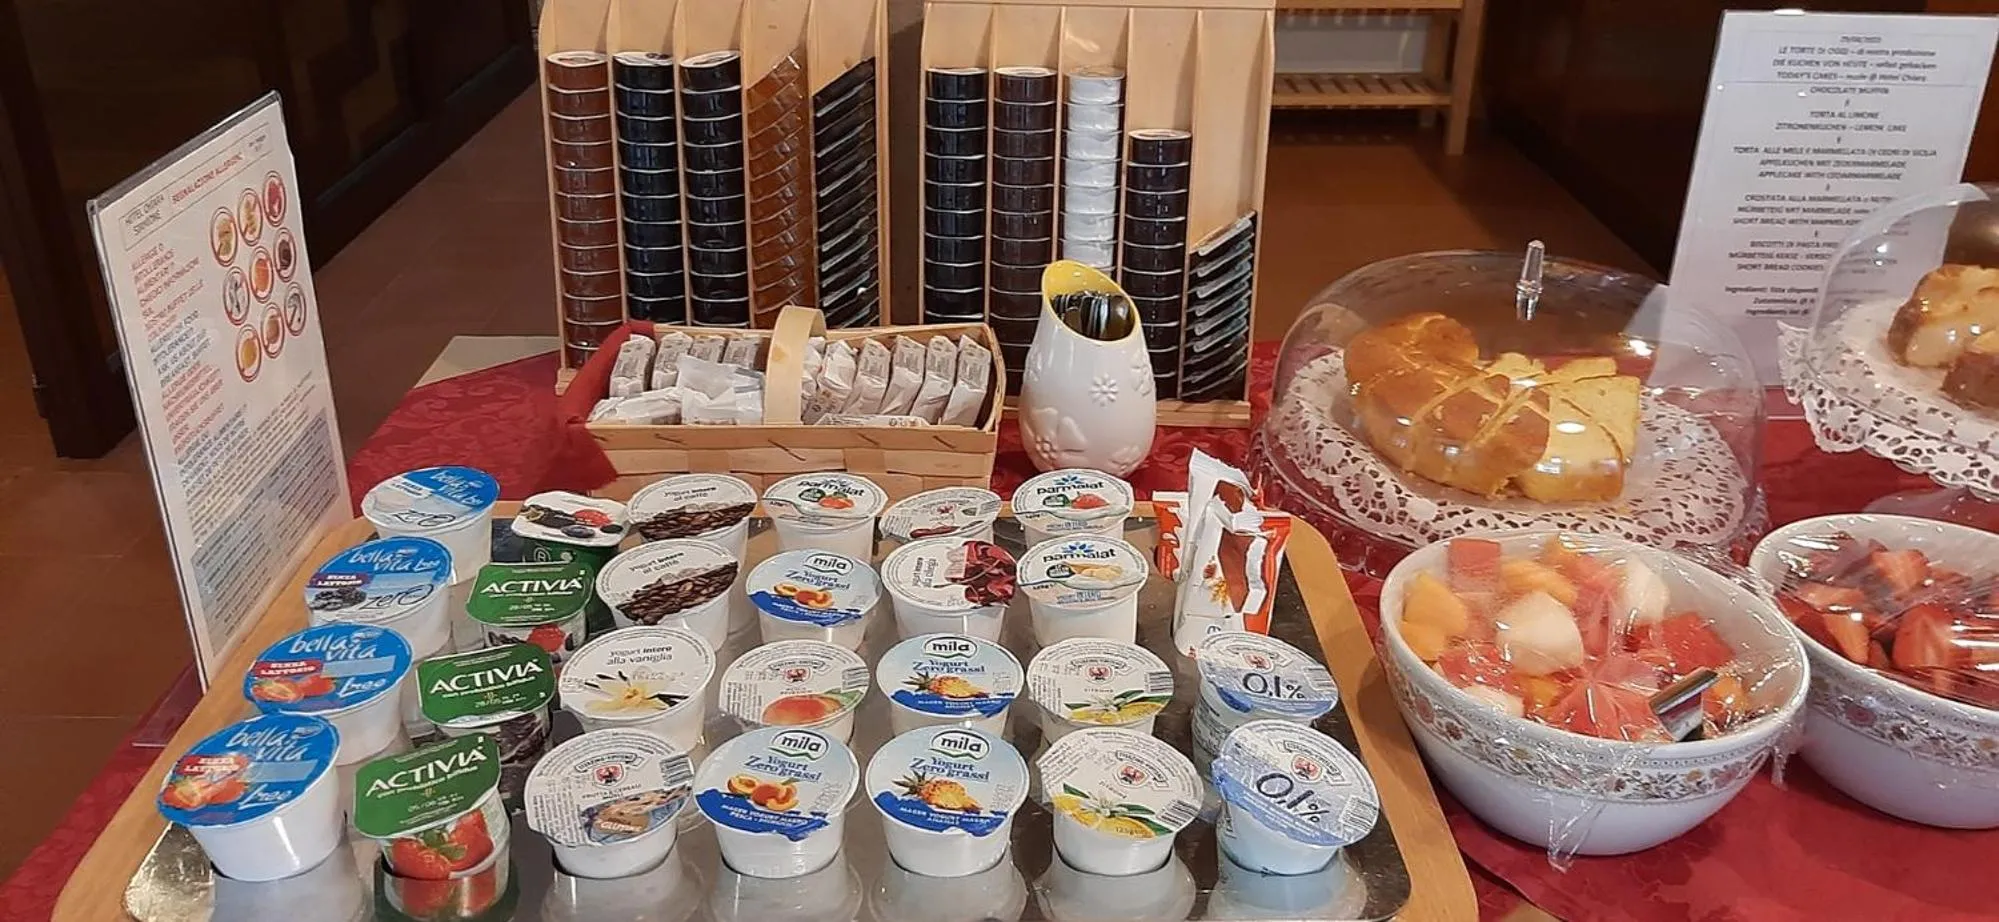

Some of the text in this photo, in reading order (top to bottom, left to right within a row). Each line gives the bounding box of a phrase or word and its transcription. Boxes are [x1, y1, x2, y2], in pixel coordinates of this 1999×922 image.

[797, 480, 866, 496] parmalat
[1037, 481, 1105, 494] parmalat
[348, 547, 399, 564] bella
[1042, 548, 1116, 563] parmalat
[814, 558, 848, 570] mila
[784, 570, 812, 584] Zero
[803, 570, 838, 582] Yogurt
[480, 578, 583, 594] ACTIVIA
[288, 632, 352, 654] bella
[642, 646, 673, 654] intero
[932, 641, 970, 652] mila
[324, 644, 376, 661] vita
[606, 653, 674, 666] alla vaniglia
[912, 662, 986, 674] Zero grassi
[929, 660, 969, 670] Yogurt
[430, 660, 544, 694] ACTIVIA
[226, 724, 290, 748] bella
[781, 735, 821, 752] mila
[254, 743, 310, 762] vita
[940, 738, 982, 752] mila
[744, 756, 824, 781] Zero grassi
[768, 756, 808, 770] Yogurt
[909, 757, 991, 781] Zero grassi
[931, 757, 976, 771] Yogurt
[365, 748, 488, 798] ACTIVIA
[1256, 772, 1330, 822] 0,1%
